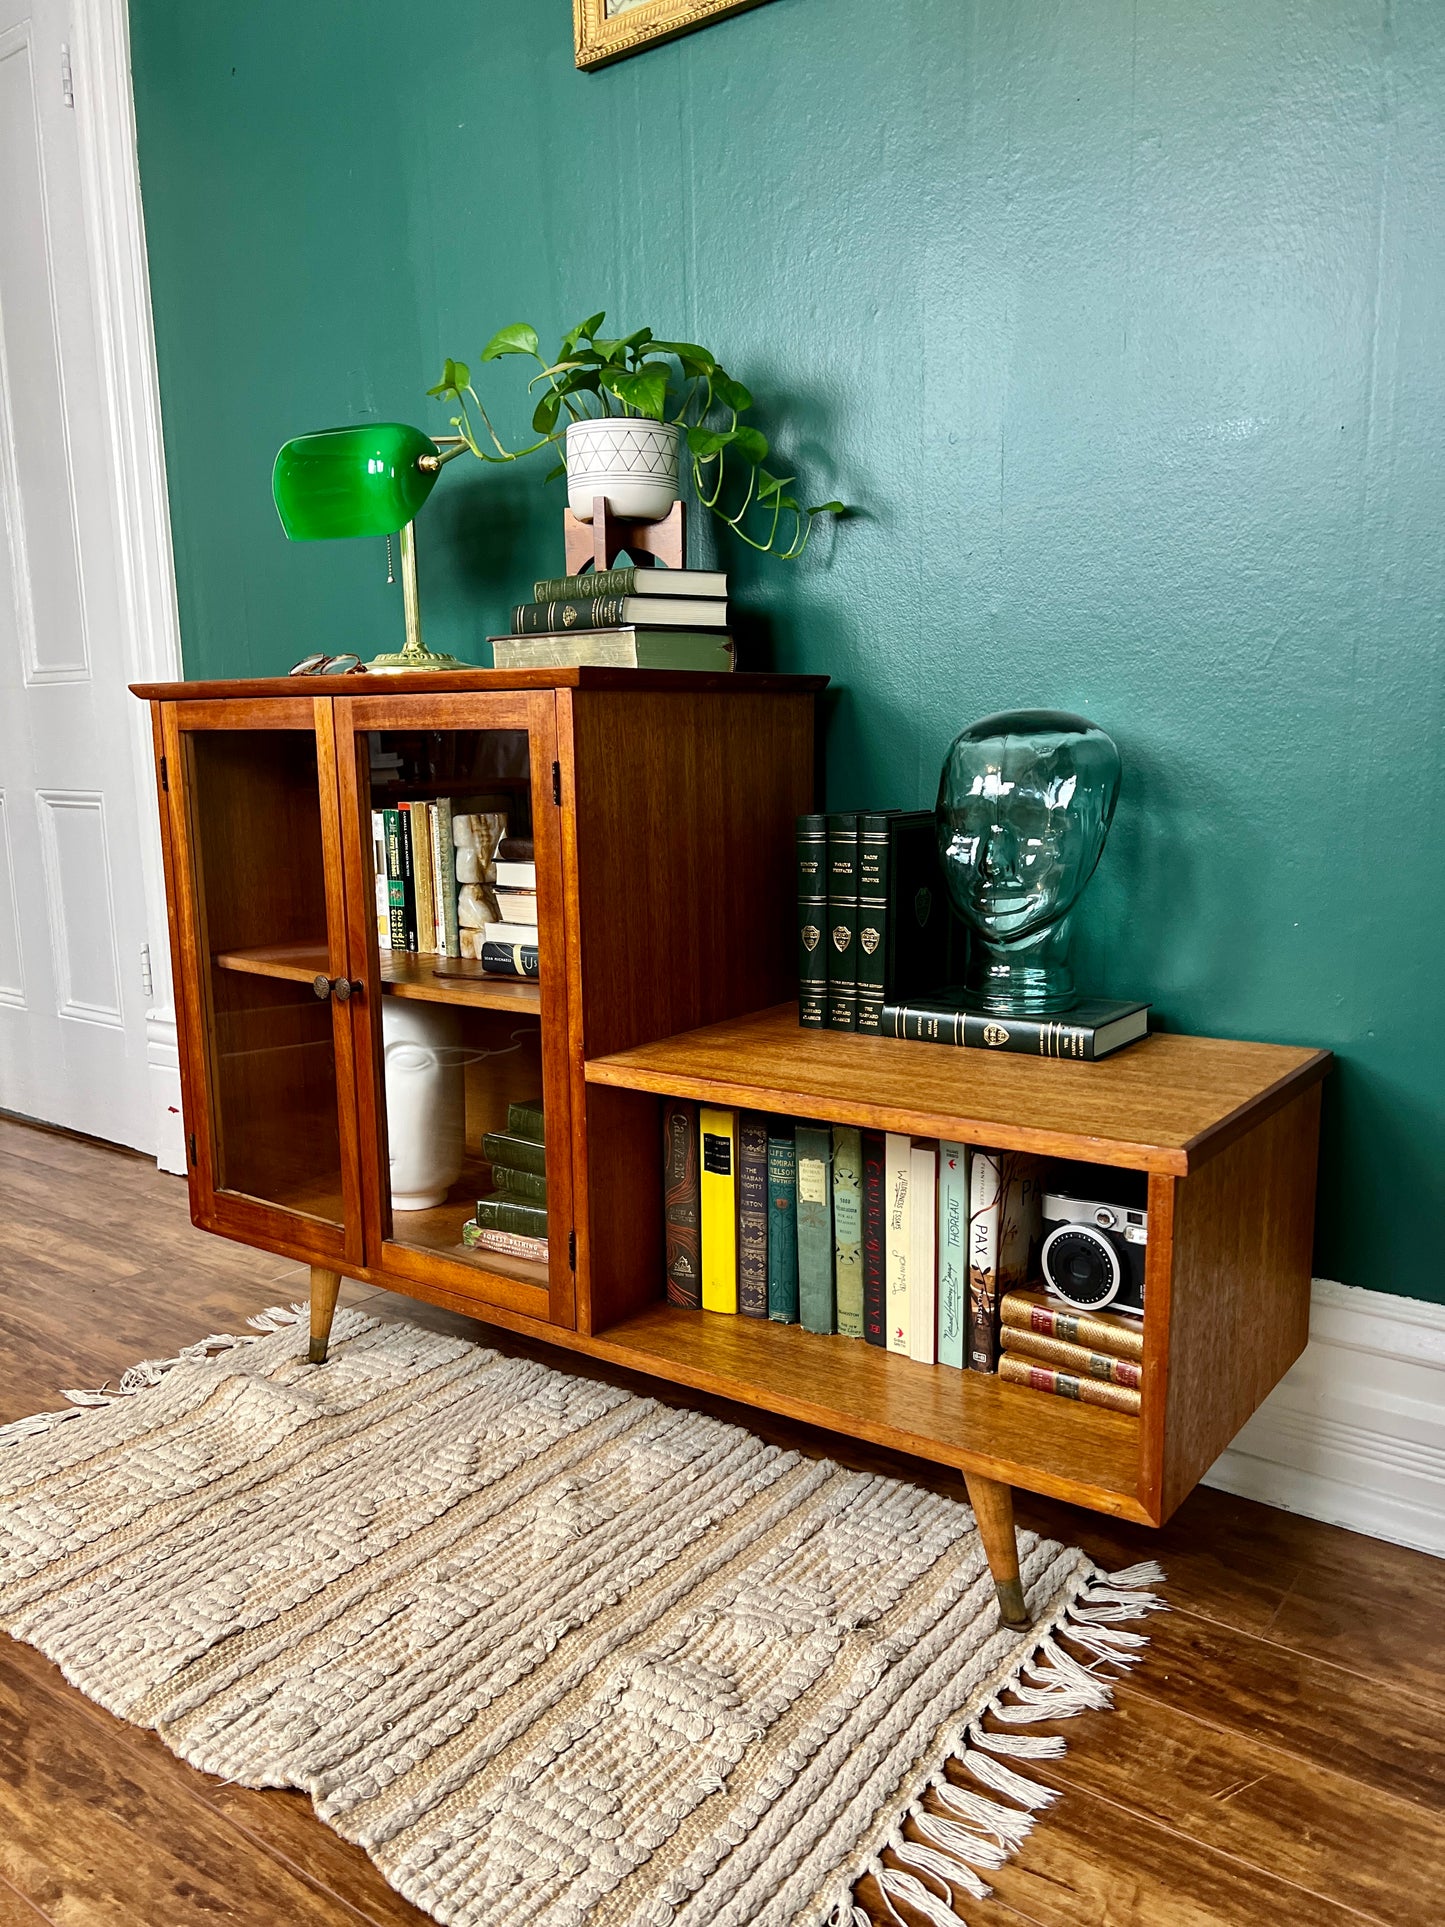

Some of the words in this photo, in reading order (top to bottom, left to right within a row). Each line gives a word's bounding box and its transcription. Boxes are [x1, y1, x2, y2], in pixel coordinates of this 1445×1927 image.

[769, 1149, 784, 1157] LIFE
[770, 1159, 795, 1167] ADMIRAL
[741, 1174, 764, 1182] ARABIAN
[745, 1166, 757, 1174] THE
[865, 1159, 880, 1229] CRUEL
[896, 1170, 908, 1209] WILDERNESS
[893, 1209, 902, 1230] ESSAYS
[948, 1198, 960, 1248] THOREAU
[483, 1232, 507, 1243] FOREST
[509, 1238, 538, 1251] BATHING
[975, 1224, 988, 1255] PAX
[865, 1237, 880, 1320] BEAUTY
